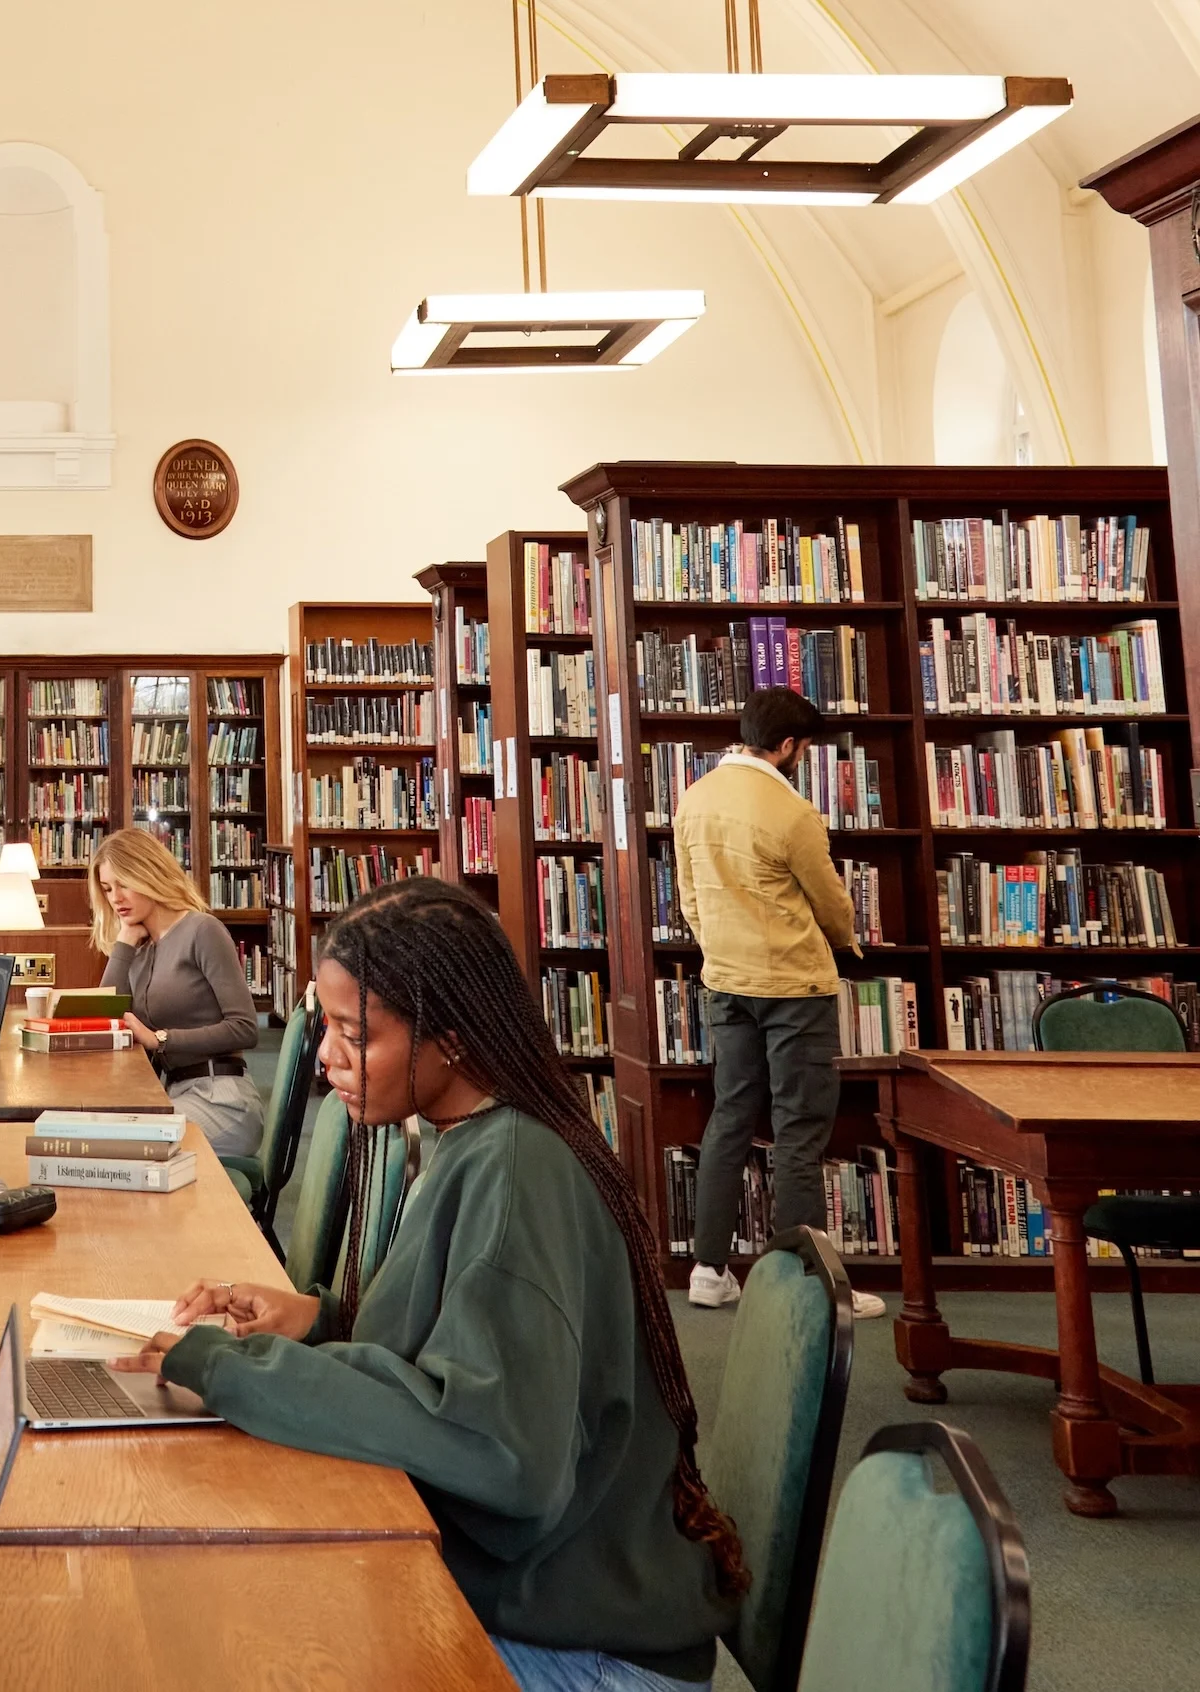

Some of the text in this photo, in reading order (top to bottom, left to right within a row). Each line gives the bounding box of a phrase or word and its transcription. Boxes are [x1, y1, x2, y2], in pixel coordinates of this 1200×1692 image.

[173, 460, 219, 471] OPENED
[167, 481, 227, 492] QUEEN MARY
[758, 643, 766, 671] OPERA
[775, 643, 784, 671] OPERA
[790, 642, 800, 680] OPERA
[967, 640, 975, 666] Popular
[57, 1165, 84, 1179] Listening
[1008, 1204, 1016, 1225] RUN
